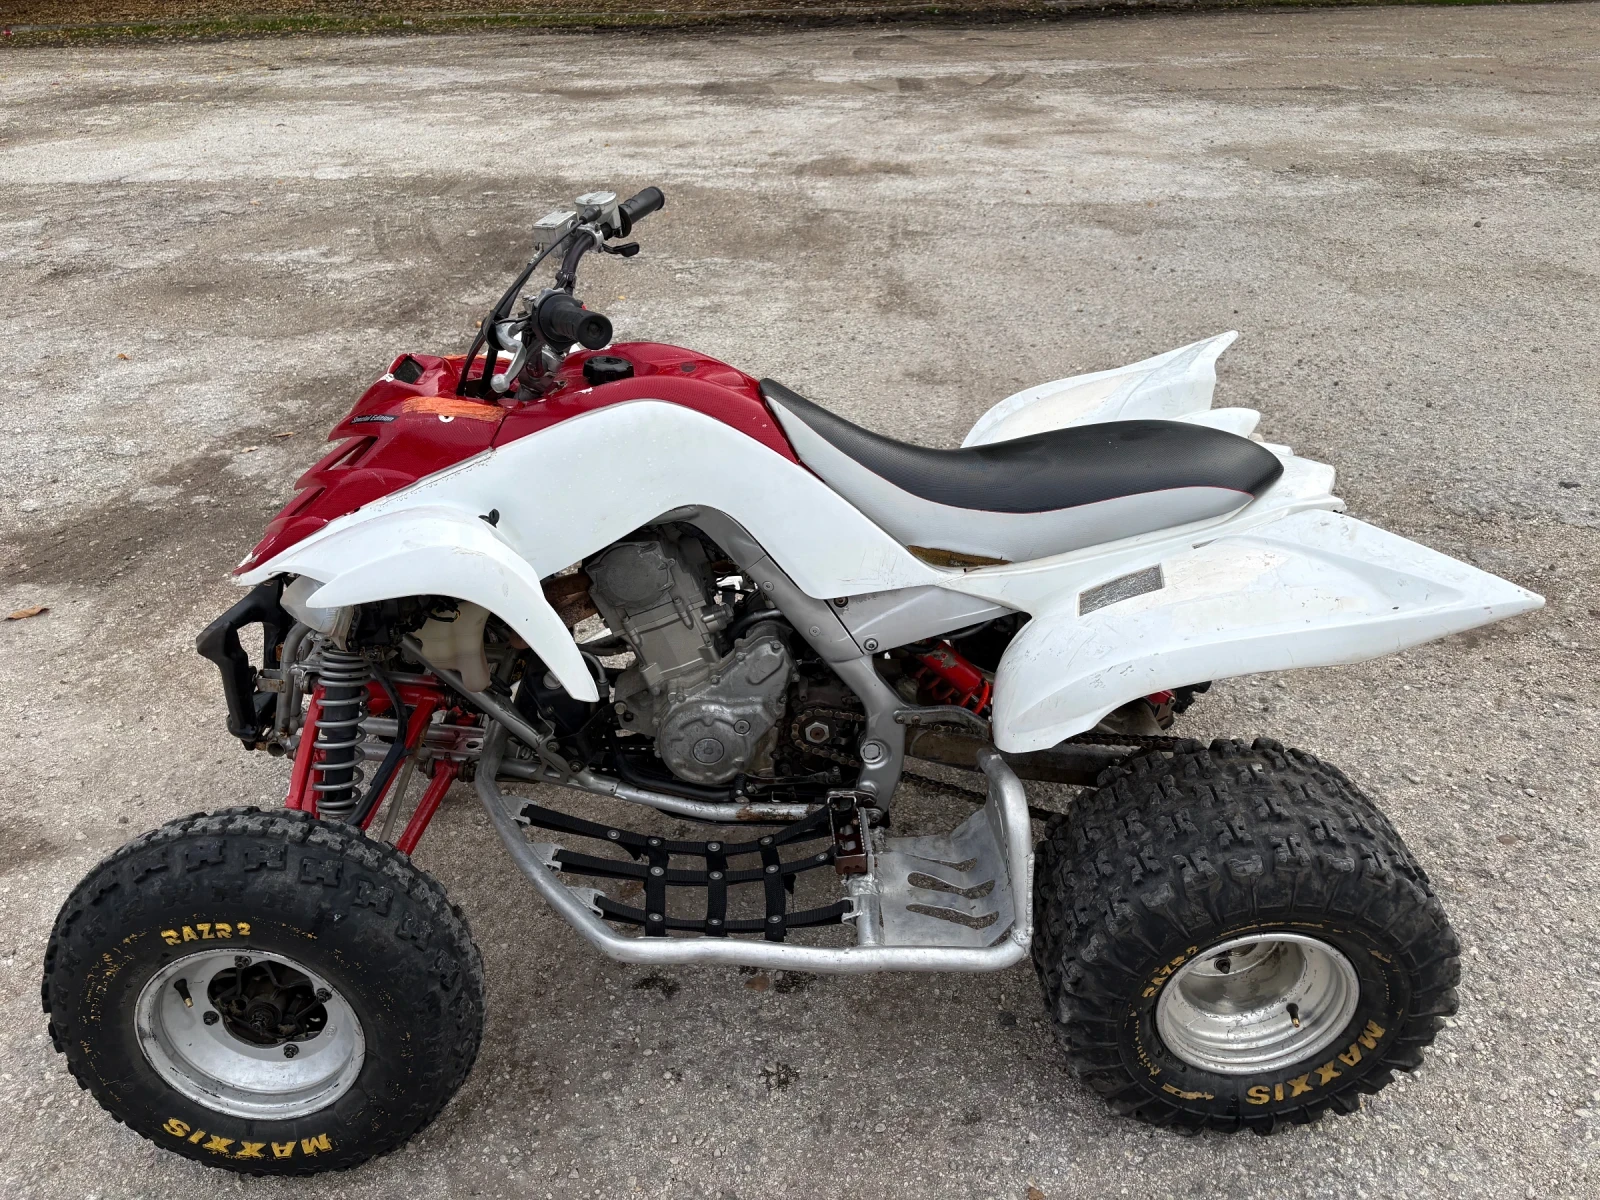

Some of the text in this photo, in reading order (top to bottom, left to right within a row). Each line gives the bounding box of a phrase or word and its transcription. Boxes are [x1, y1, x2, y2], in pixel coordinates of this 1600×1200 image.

[160, 921, 251, 946] RAZR 2
[1245, 1018, 1386, 1105] MAXXIS
[162, 1116, 333, 1160] MAXXIS
